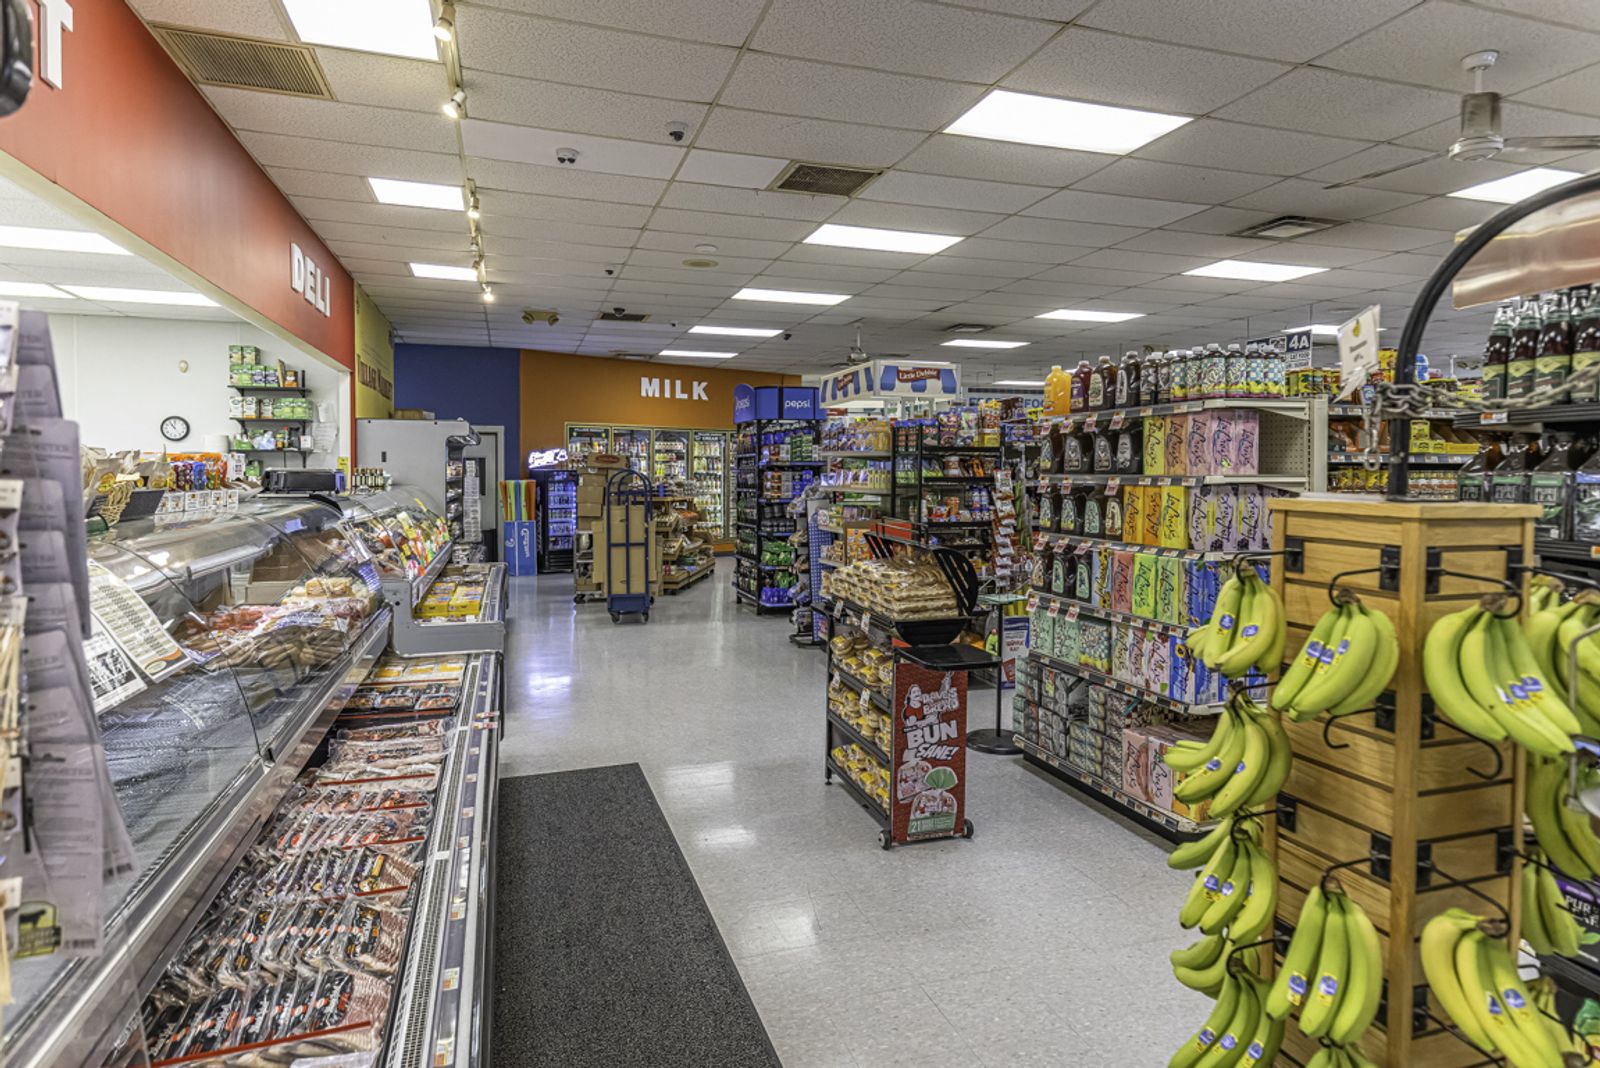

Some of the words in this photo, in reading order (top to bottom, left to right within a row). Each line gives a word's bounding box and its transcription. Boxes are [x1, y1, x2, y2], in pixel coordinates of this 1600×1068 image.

[289, 241, 331, 318] DELI
[1289, 335, 1309, 350] 4A
[640, 377, 709, 401] MILK
[784, 399, 811, 409] pepsi
[907, 720, 958, 750] BUN
[916, 743, 960, 760] SANE!
